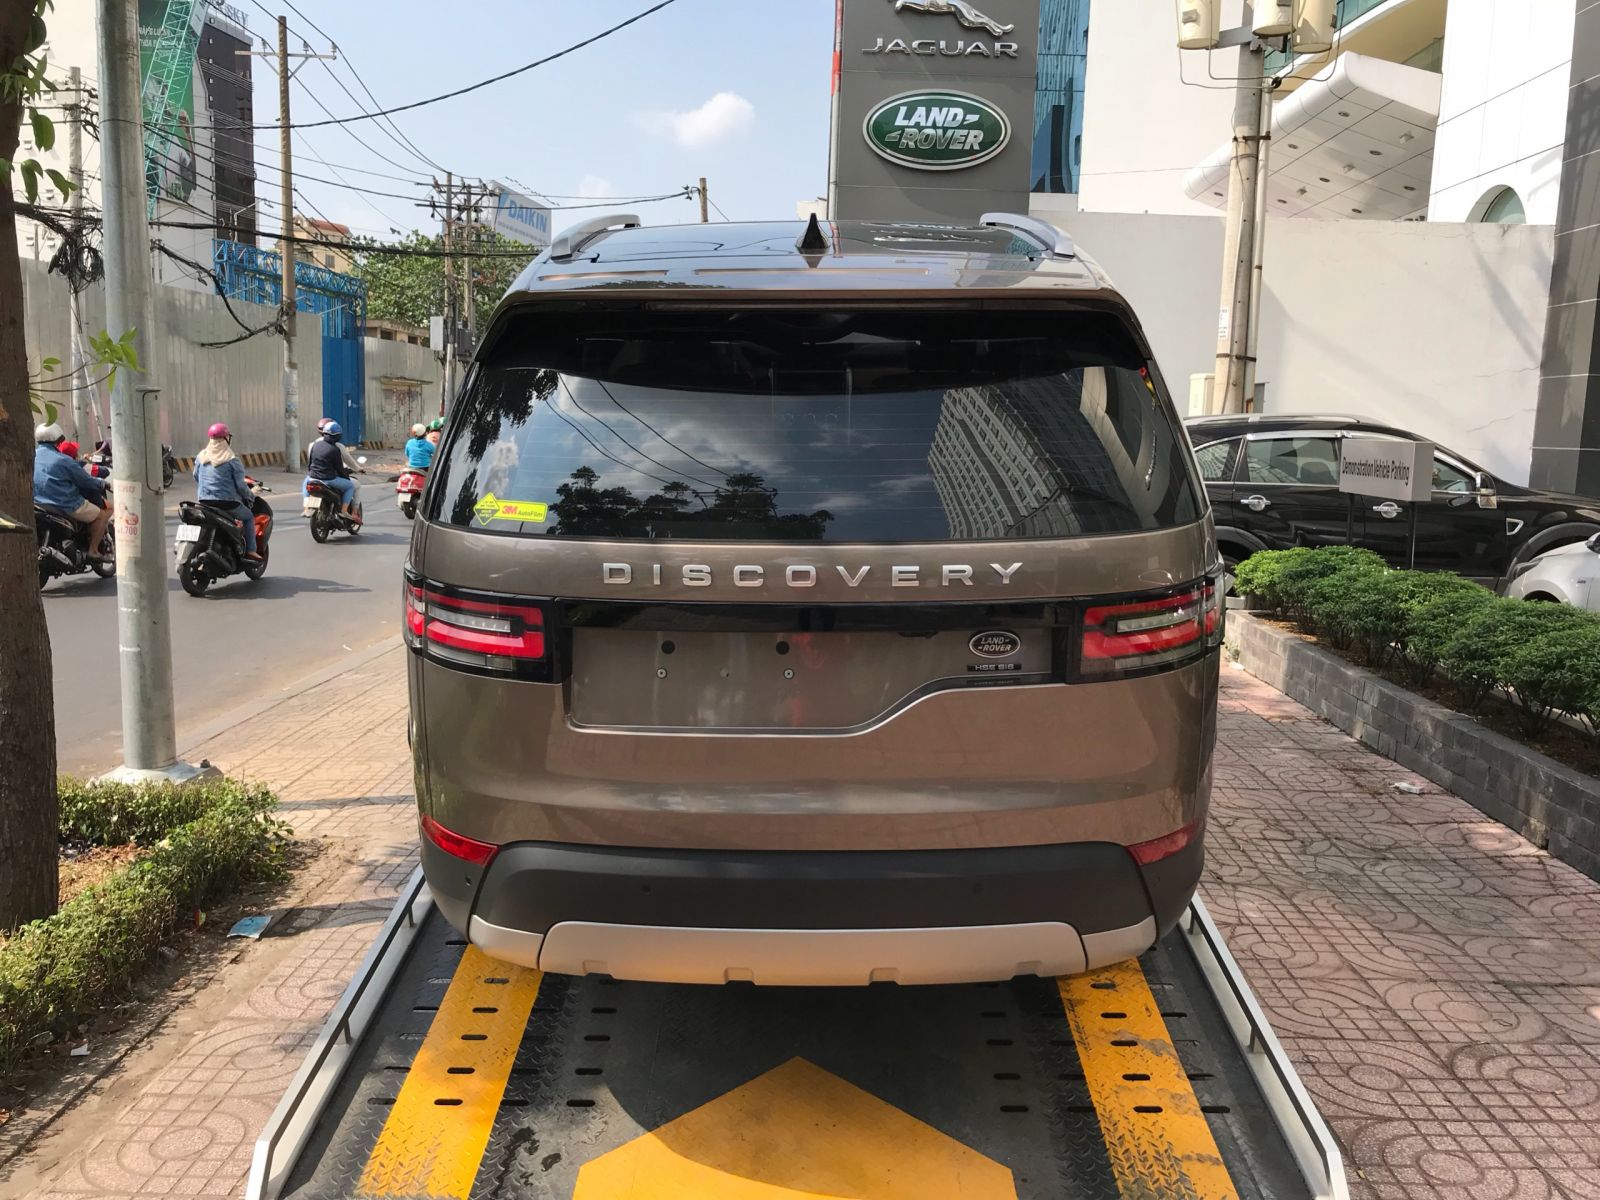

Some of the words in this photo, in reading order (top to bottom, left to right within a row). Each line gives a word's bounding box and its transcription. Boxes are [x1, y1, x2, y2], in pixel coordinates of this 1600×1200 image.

[861, 37, 1019, 57] JAGUAR
[894, 105, 964, 128] LAND
[898, 127, 984, 151] ROVER
[508, 199, 548, 233] DAIKIN
[1342, 456, 1373, 477] Demonstration
[1373, 459, 1390, 480] Vehicle
[1390, 460, 1410, 487] Parking
[502, 505, 518, 515] 3M
[518, 510, 544, 518] AutoFilm
[602, 561, 1025, 588] DISCOVERY
